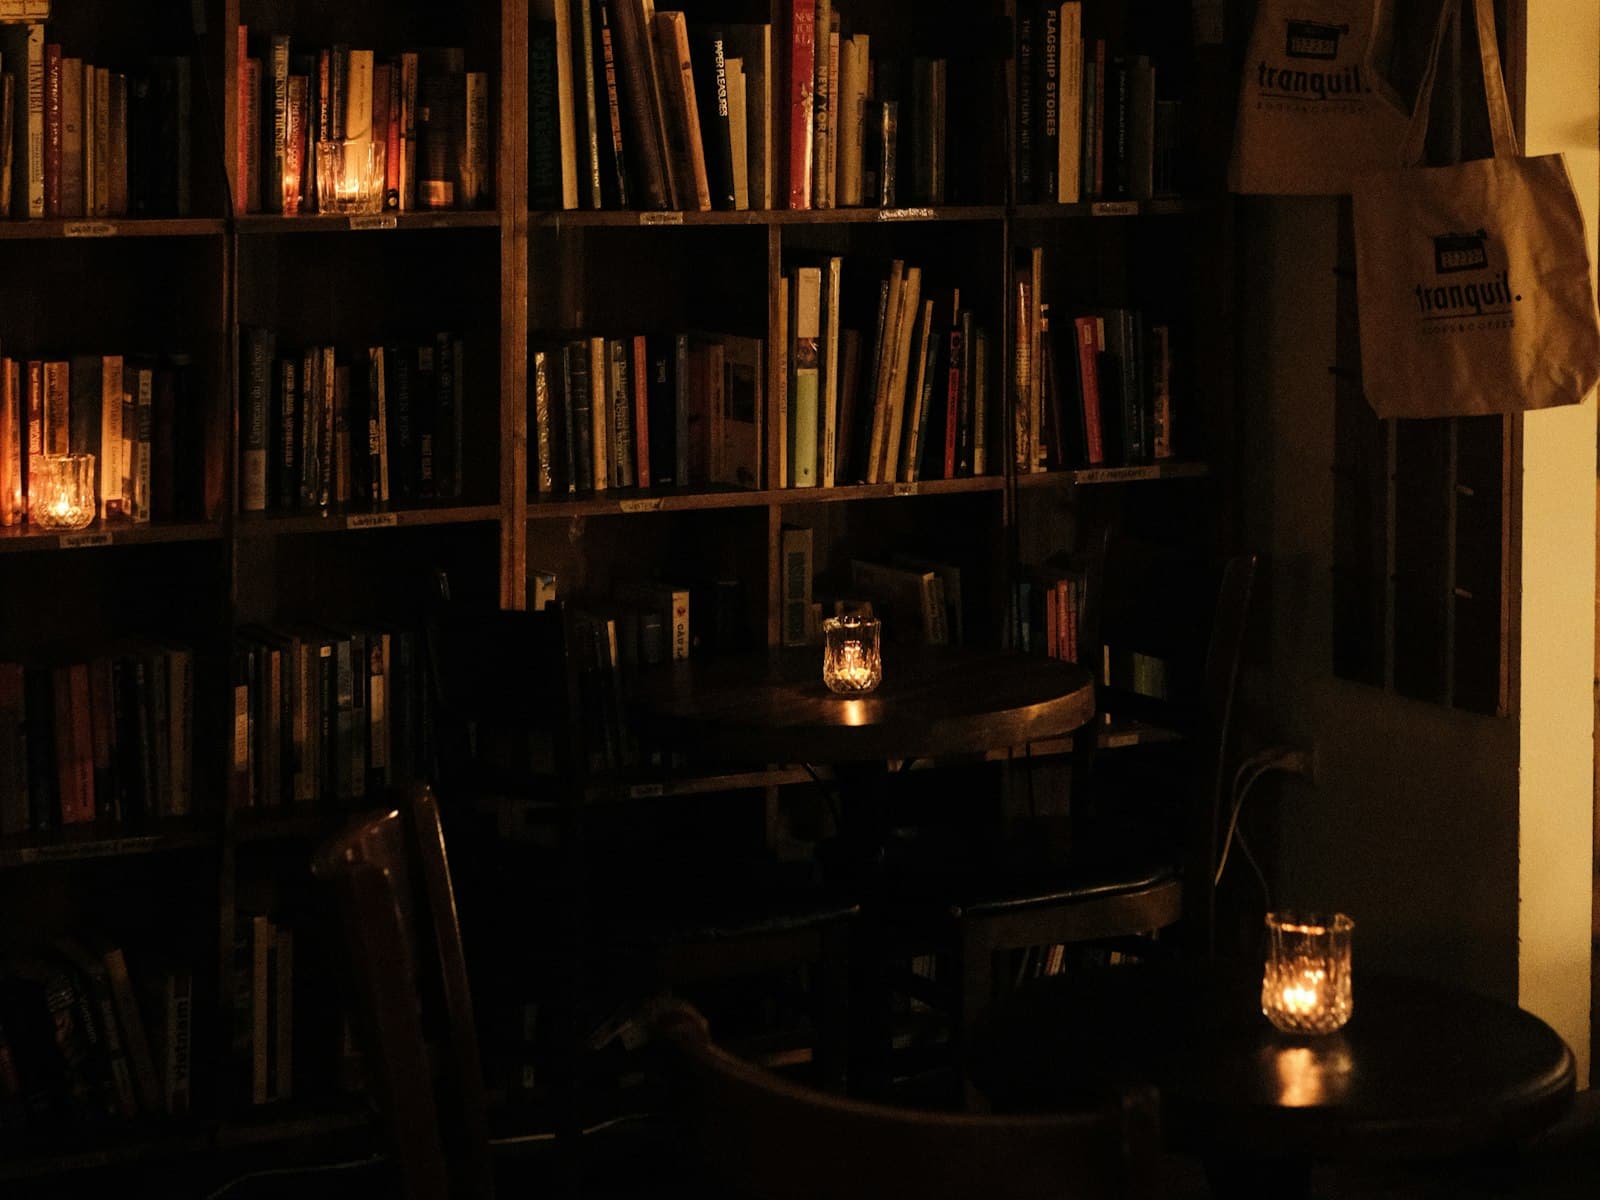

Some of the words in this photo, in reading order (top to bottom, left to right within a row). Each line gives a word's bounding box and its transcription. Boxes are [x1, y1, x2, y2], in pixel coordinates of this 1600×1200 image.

[714, 40, 725, 67] PAPER
[1046, 9, 1057, 78] FLAGSHIP
[275, 64, 284, 98] SOUND
[715, 68, 728, 117] PLEASURES
[817, 65, 828, 98] NEW
[1257, 60, 1371, 101] tranquil.
[817, 102, 828, 141] YORK
[1046, 81, 1057, 137] STORES
[275, 113, 284, 158] THUNDER
[1415, 269, 1522, 316] tranquil.
